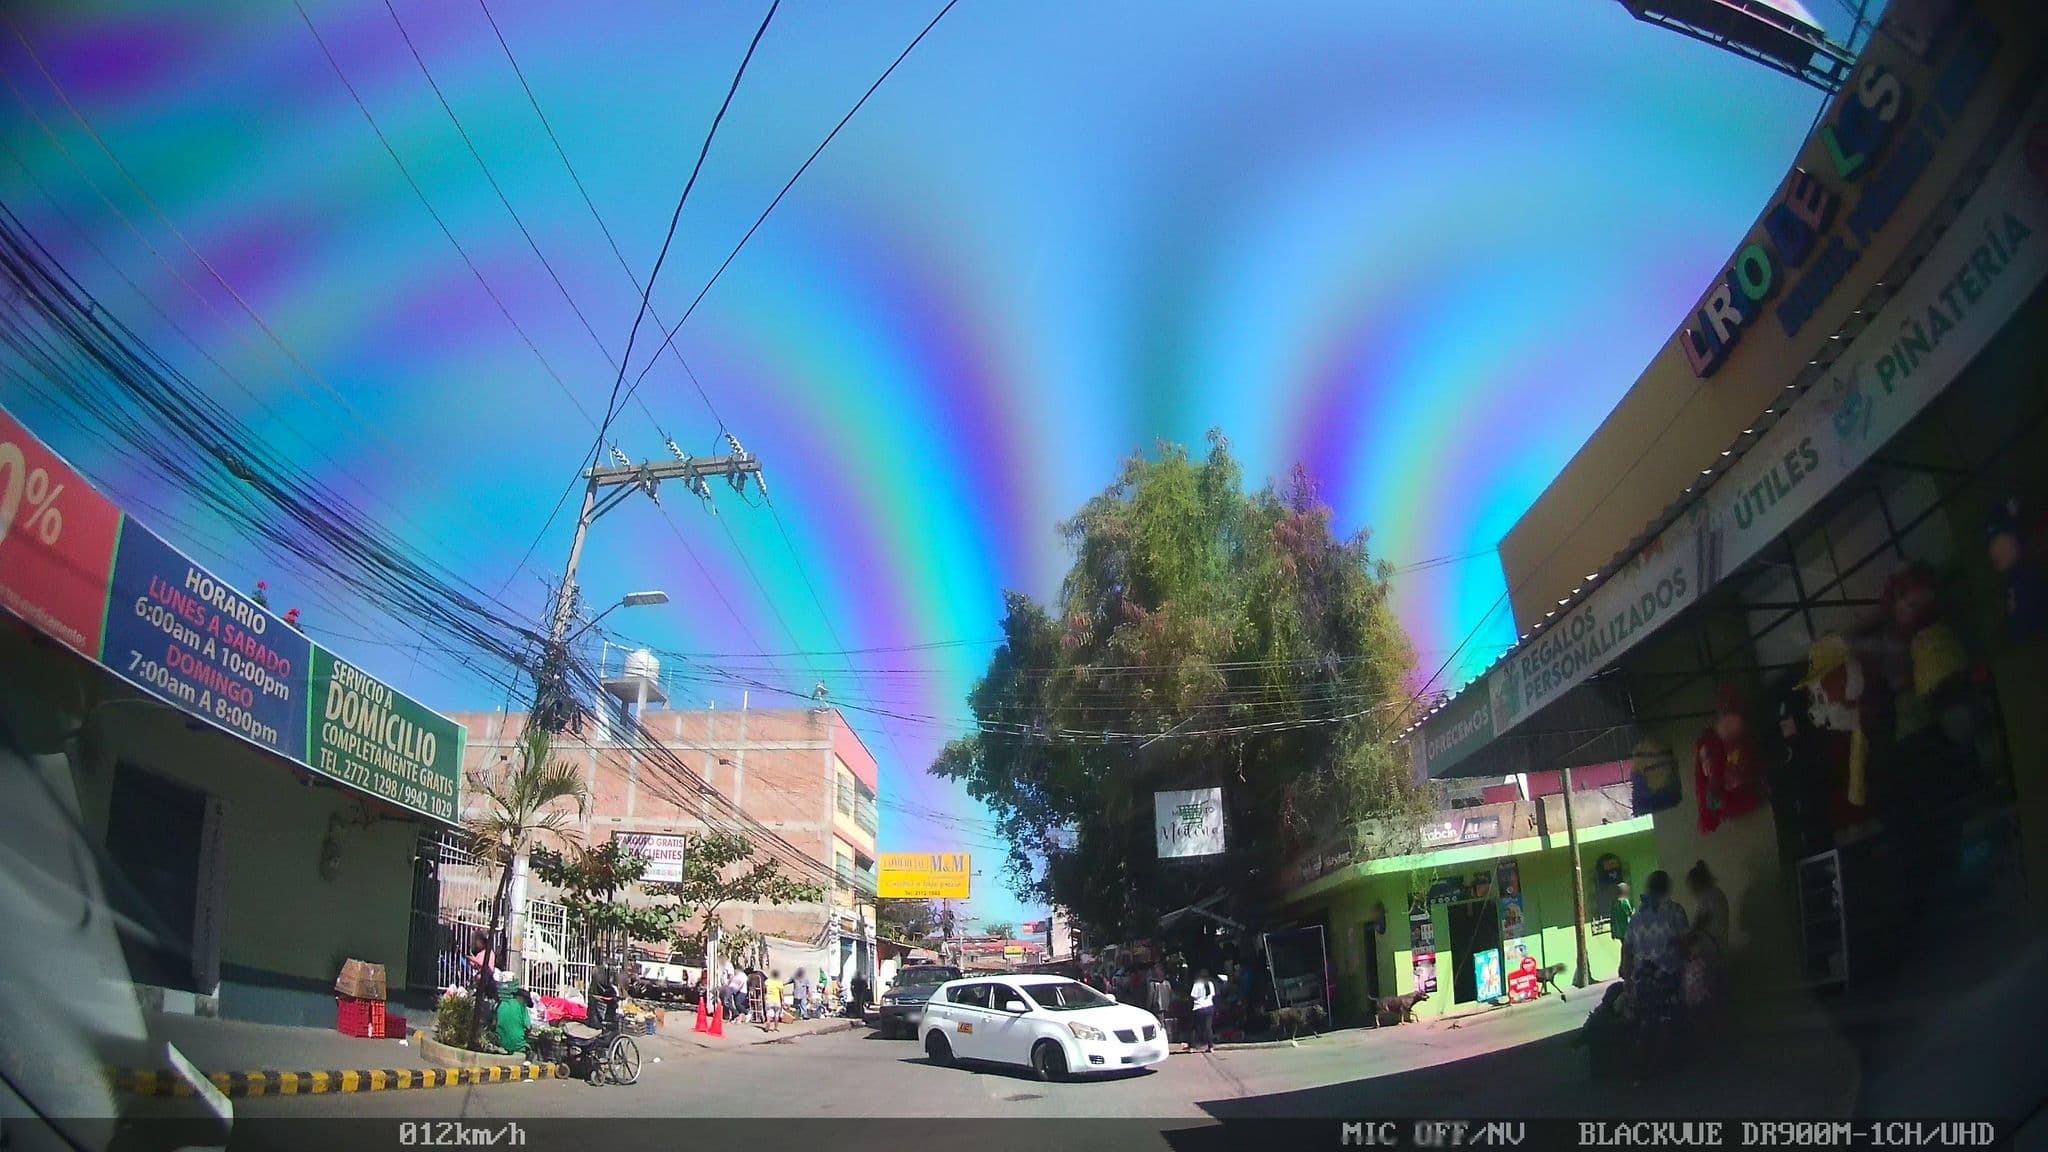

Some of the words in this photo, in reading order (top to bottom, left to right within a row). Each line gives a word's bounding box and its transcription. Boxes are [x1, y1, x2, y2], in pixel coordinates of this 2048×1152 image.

[1875, 211, 2033, 395] PIÑATERÍA
[1733, 436, 1819, 530] ÚTILES
[149, 575, 207, 626] LUNES
[207, 615, 220, 637] A
[222, 623, 291, 678] SABADO
[185, 567, 266, 635] HORARIO
[1524, 567, 1688, 707] PERSONALIZADOS
[135, 596, 200, 650] 6:00am
[202, 637, 216, 660] A
[222, 647, 289, 701] 10:00pm
[166, 644, 254, 708] DOMINGO
[1521, 604, 1597, 679] REGALOS
[128, 650, 196, 702] 7:00am
[198, 690, 211, 712] A
[215, 698, 278, 744] 8:00pm
[331, 659, 384, 705] SERVICIO
[384, 691, 393, 711] A
[322, 722, 419, 783] COMPLETAMENTE
[419, 767, 453, 797] GRATIS
[325, 680, 436, 768] DOMICILIO
[1426, 705, 1489, 761] OFRECEMOS
[320, 747, 341, 776] TEL.
[343, 759, 370, 788] 2772
[374, 772, 397, 797] 1298
[405, 786, 427, 810] 9942
[431, 795, 452, 819] 1029
[655, 838, 683, 848] GRATIS
[931, 855, 964, 872] M&M
